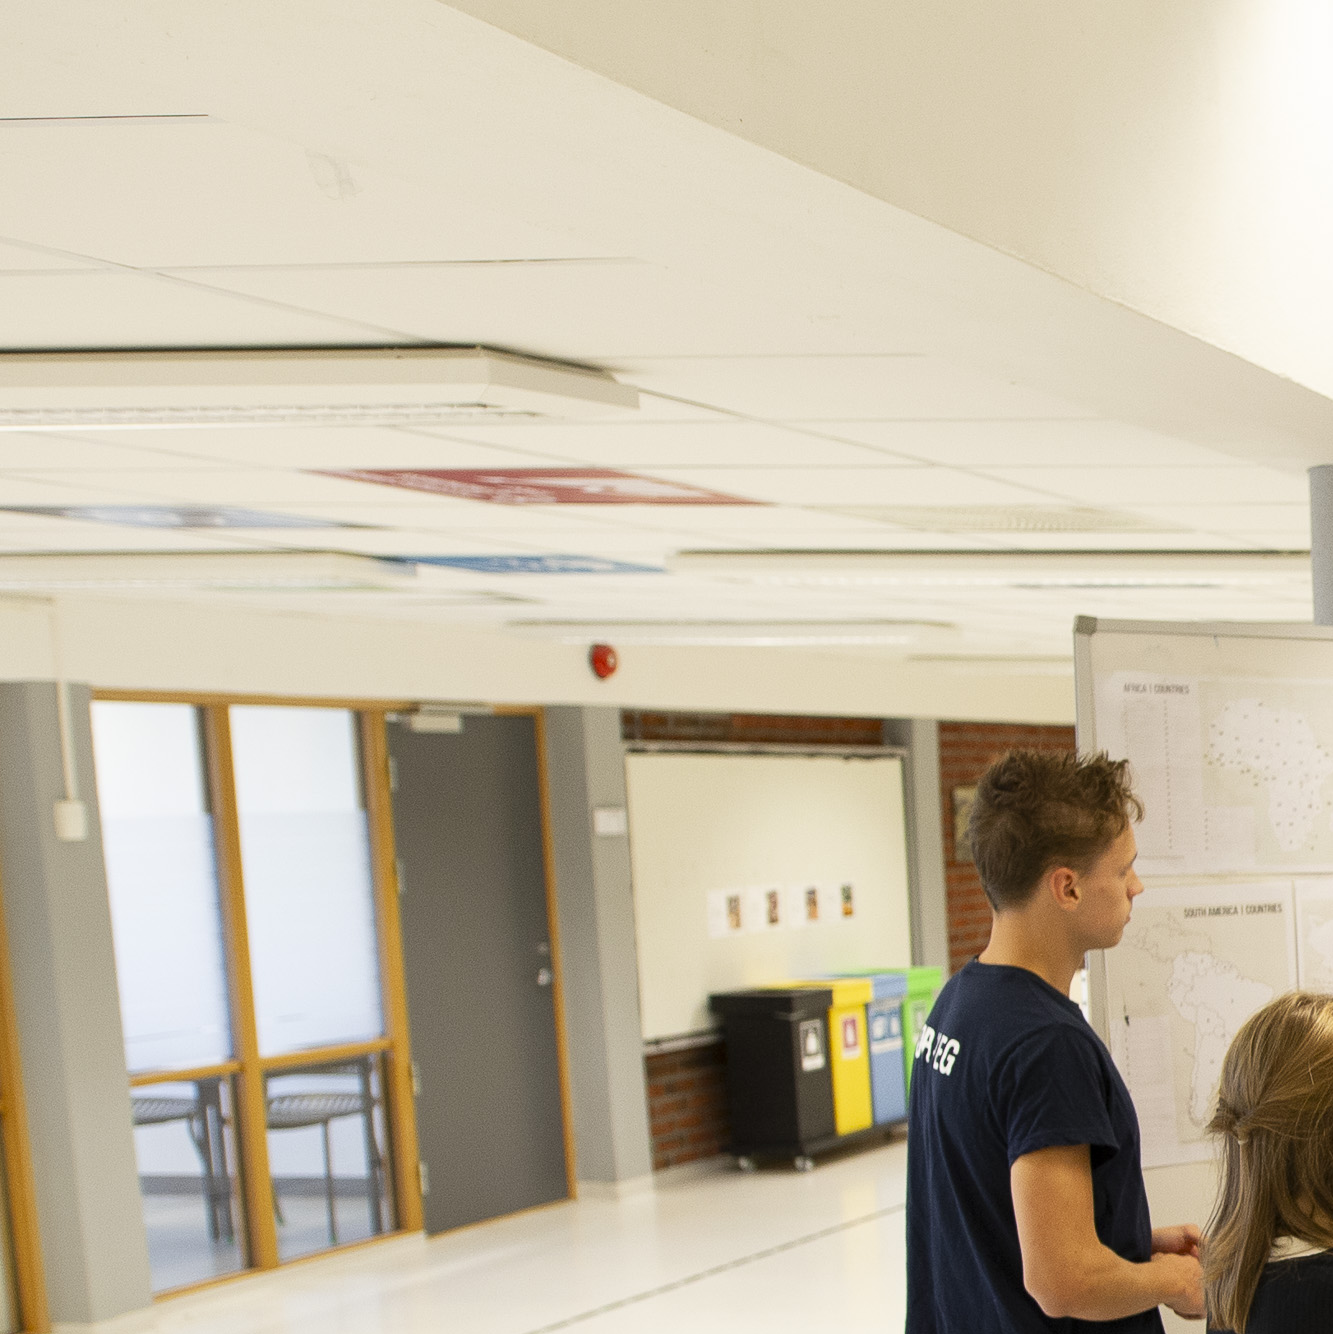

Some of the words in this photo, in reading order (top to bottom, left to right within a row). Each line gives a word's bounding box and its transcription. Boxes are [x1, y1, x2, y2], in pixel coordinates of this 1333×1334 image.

[1183, 906, 1207, 919] SOUTH
[1207, 904, 1239, 917] AMERICA
[1245, 902, 1283, 915] COUNTRIES
[933, 1032, 960, 1076] EG
